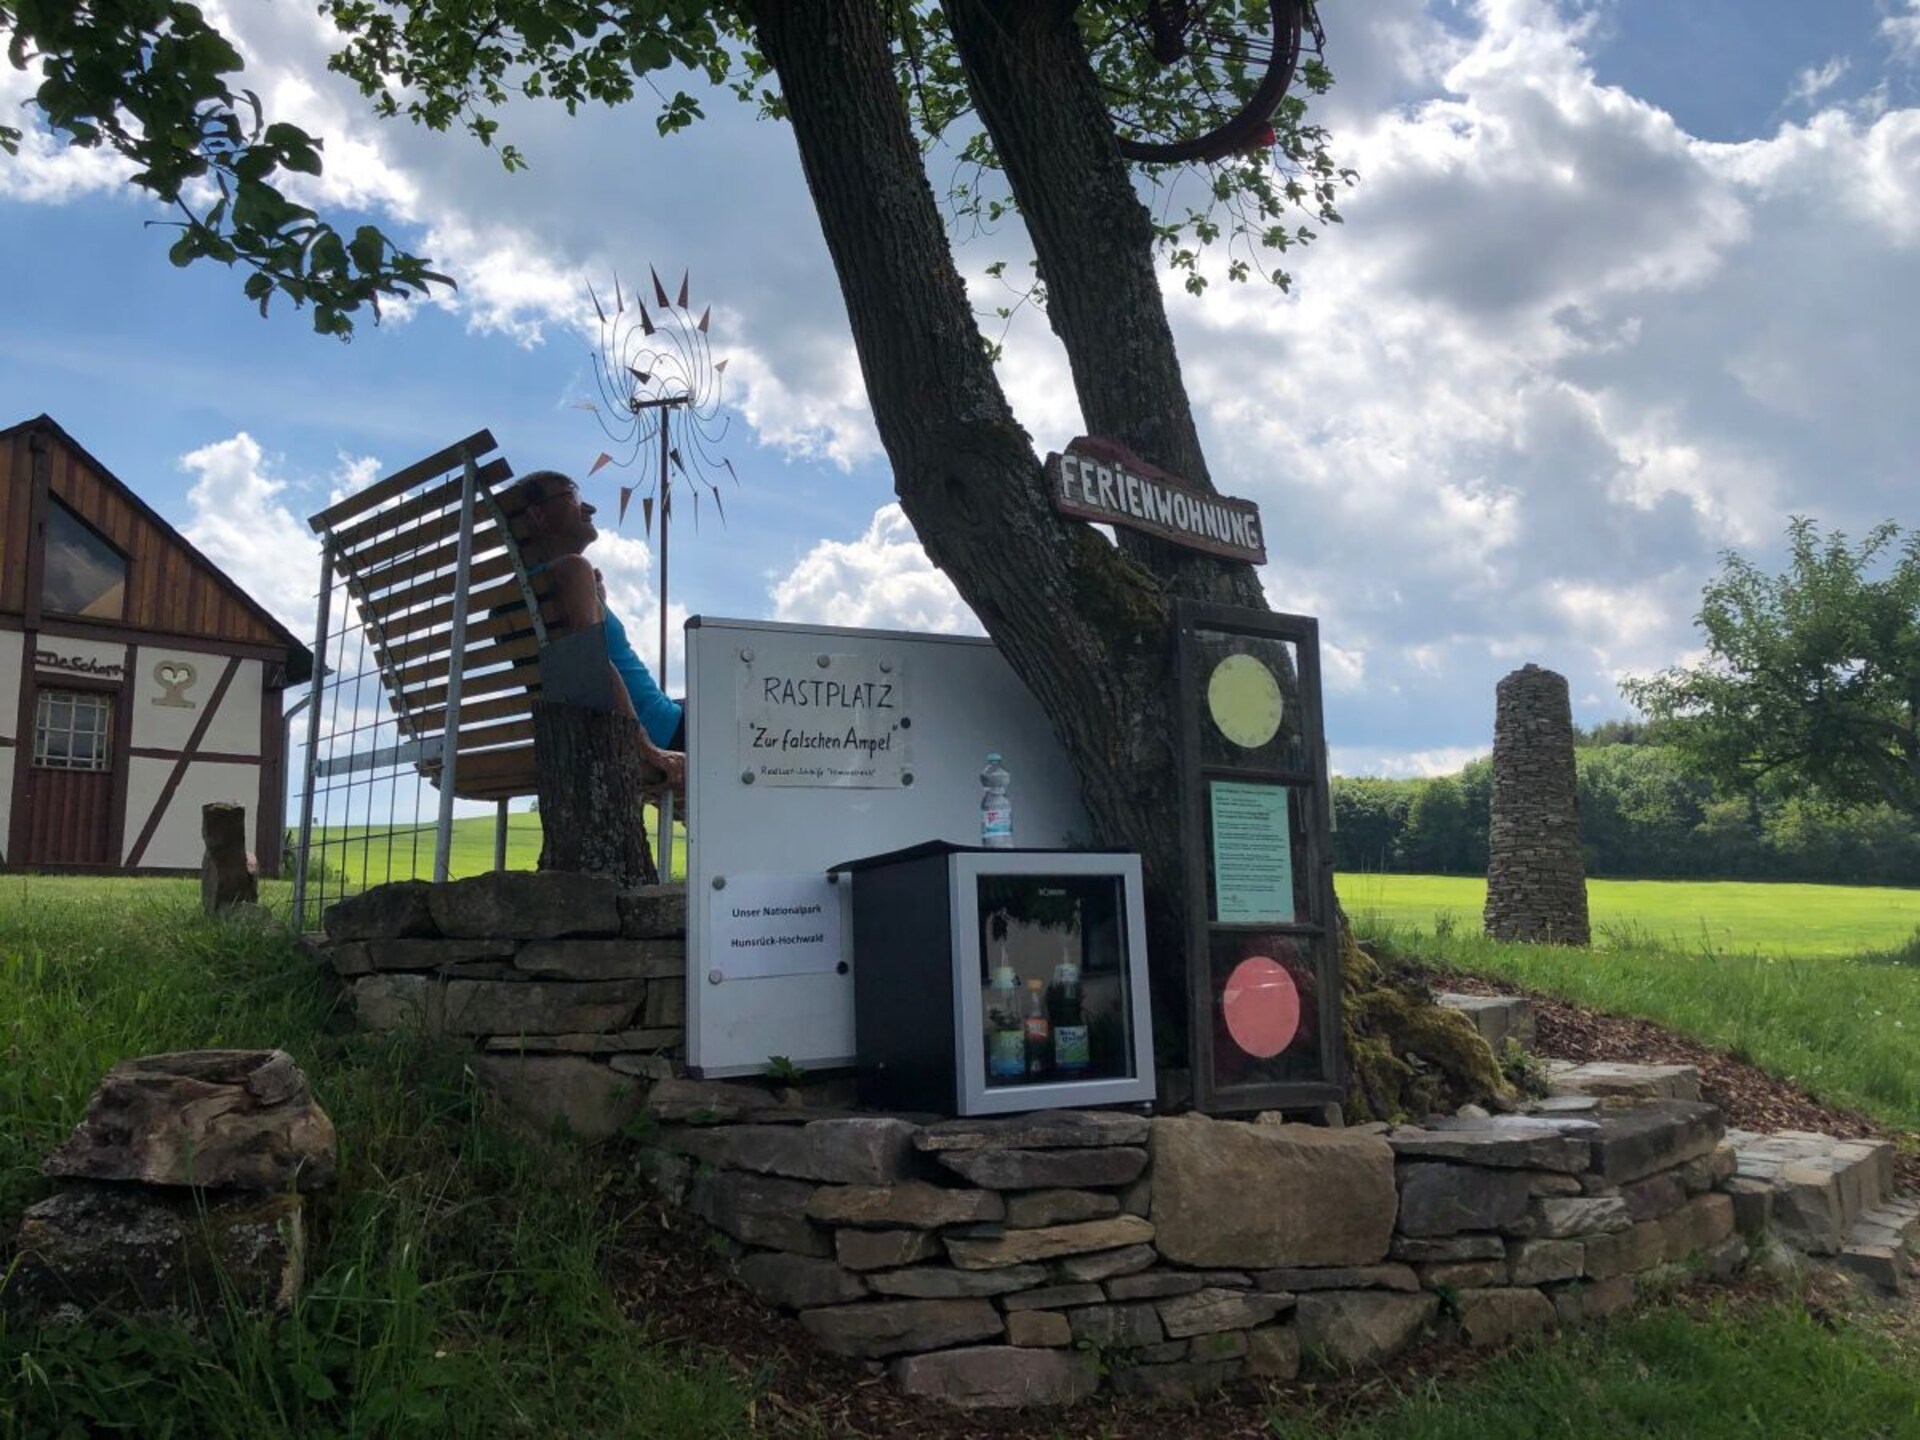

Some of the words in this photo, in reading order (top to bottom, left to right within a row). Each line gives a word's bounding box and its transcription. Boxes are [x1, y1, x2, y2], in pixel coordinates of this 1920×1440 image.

[762, 677, 894, 709] RASTPLATZ
[782, 729, 841, 751] falschen
[732, 908, 760, 918] Unser
[763, 904, 822, 917] Nationalpark
[731, 934, 824, 948] Hunsrück-Hochwald
